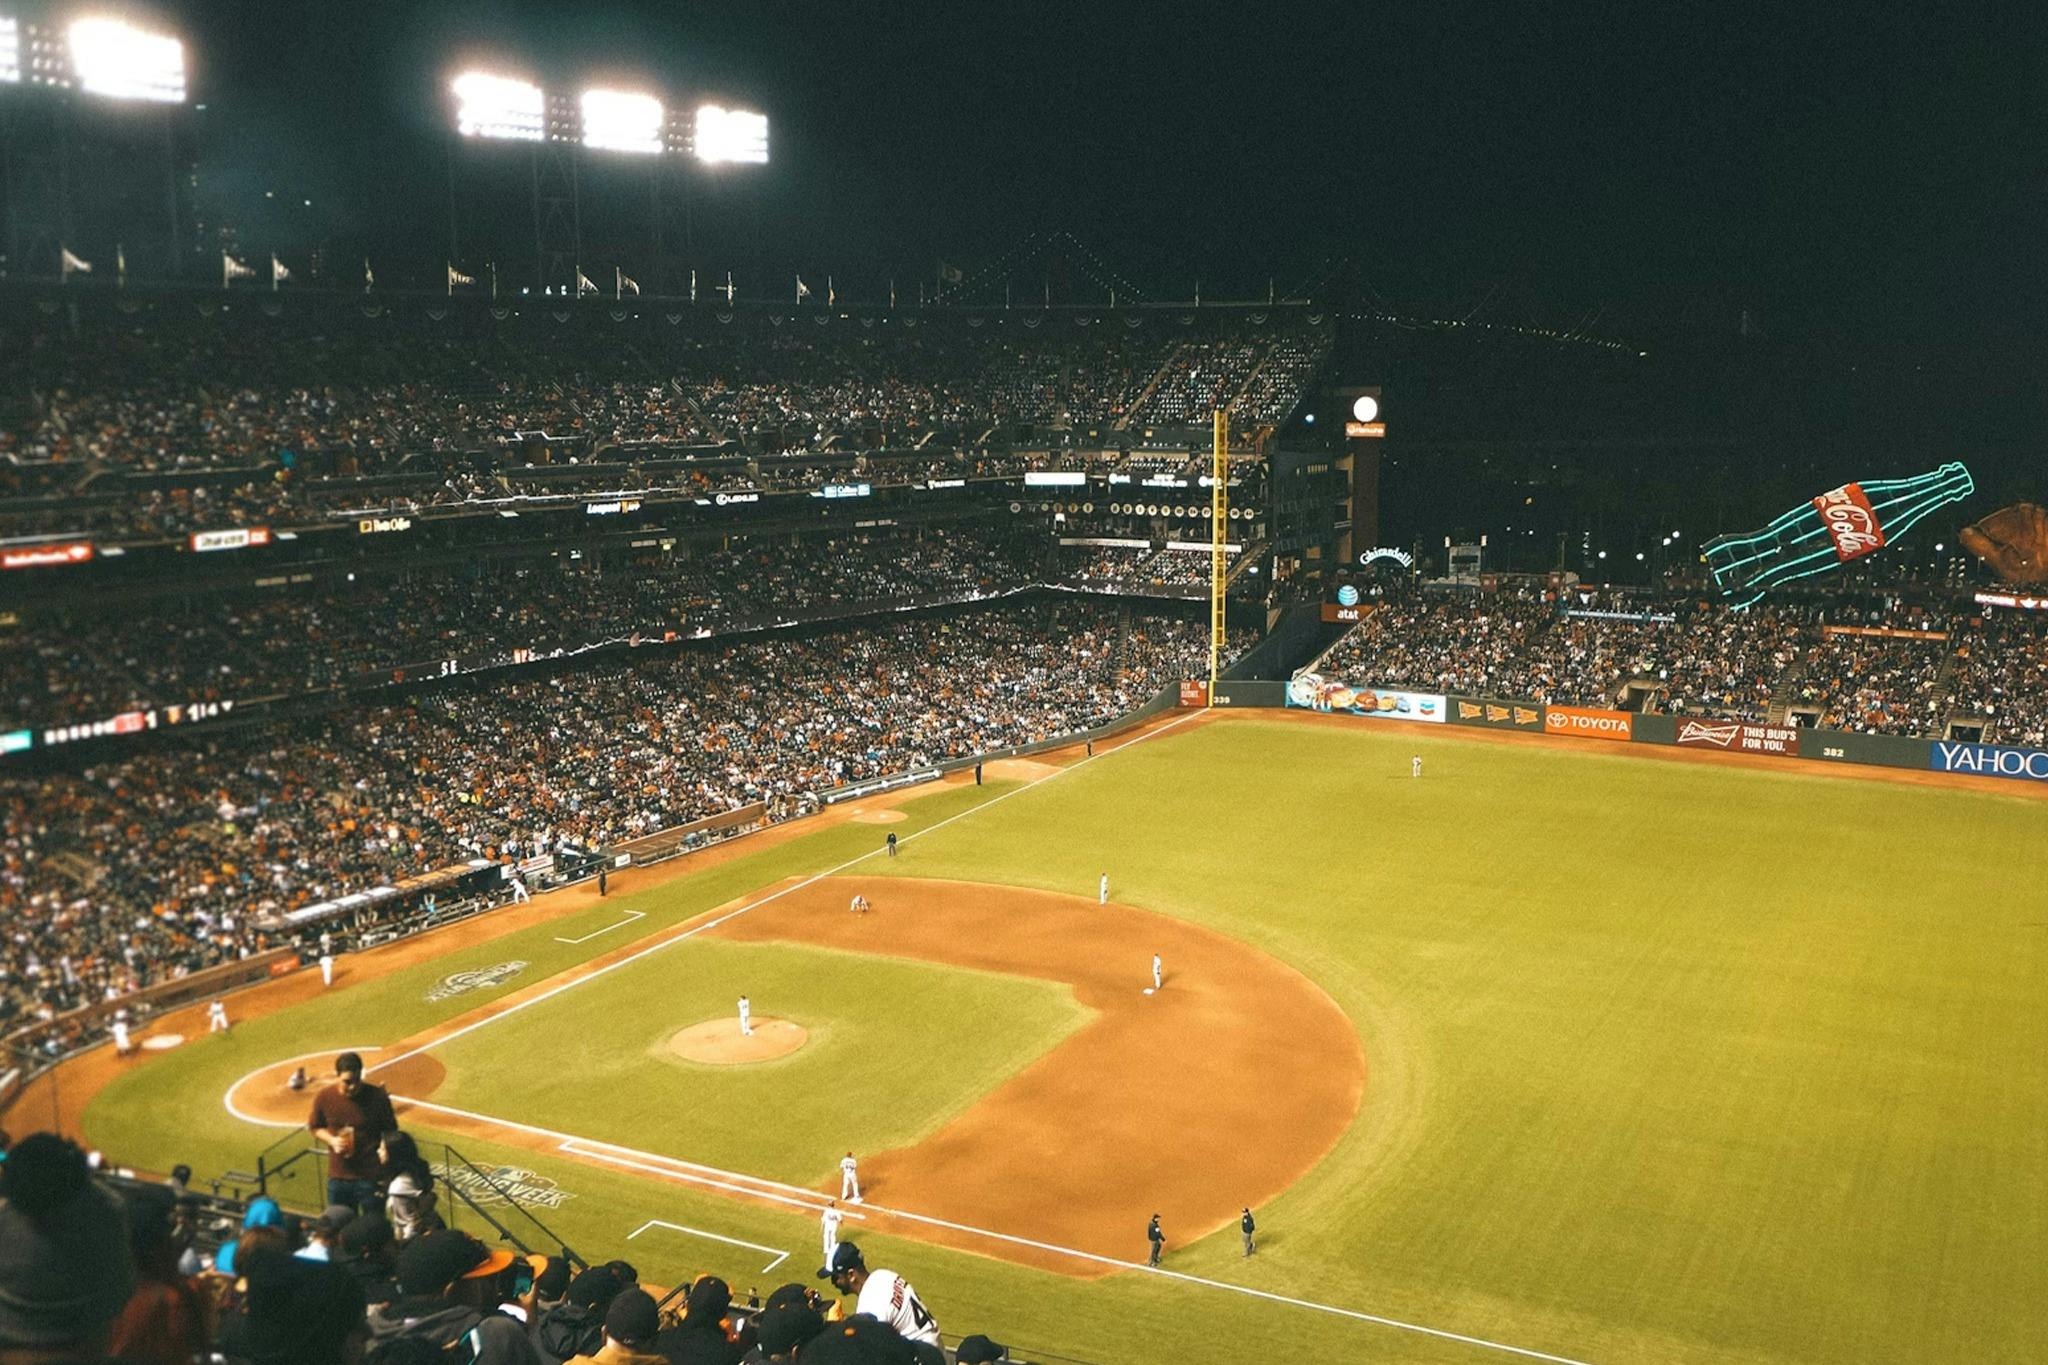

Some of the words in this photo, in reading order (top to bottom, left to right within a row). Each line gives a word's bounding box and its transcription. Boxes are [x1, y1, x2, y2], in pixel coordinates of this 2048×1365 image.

[1360, 547, 1413, 568] Ghirardelli
[1337, 609, 1359, 620] at&t
[1570, 716, 1630, 732] TOYOTA
[1681, 725, 1737, 740] Budweiser
[1742, 726, 1766, 738] THIS
[1767, 729, 1797, 741] BUD'S
[1742, 738, 1761, 749] FOR
[1763, 740, 1786, 752] YOU.
[1823, 748, 1844, 757] 382
[505, 1181, 566, 1207] WEEK
